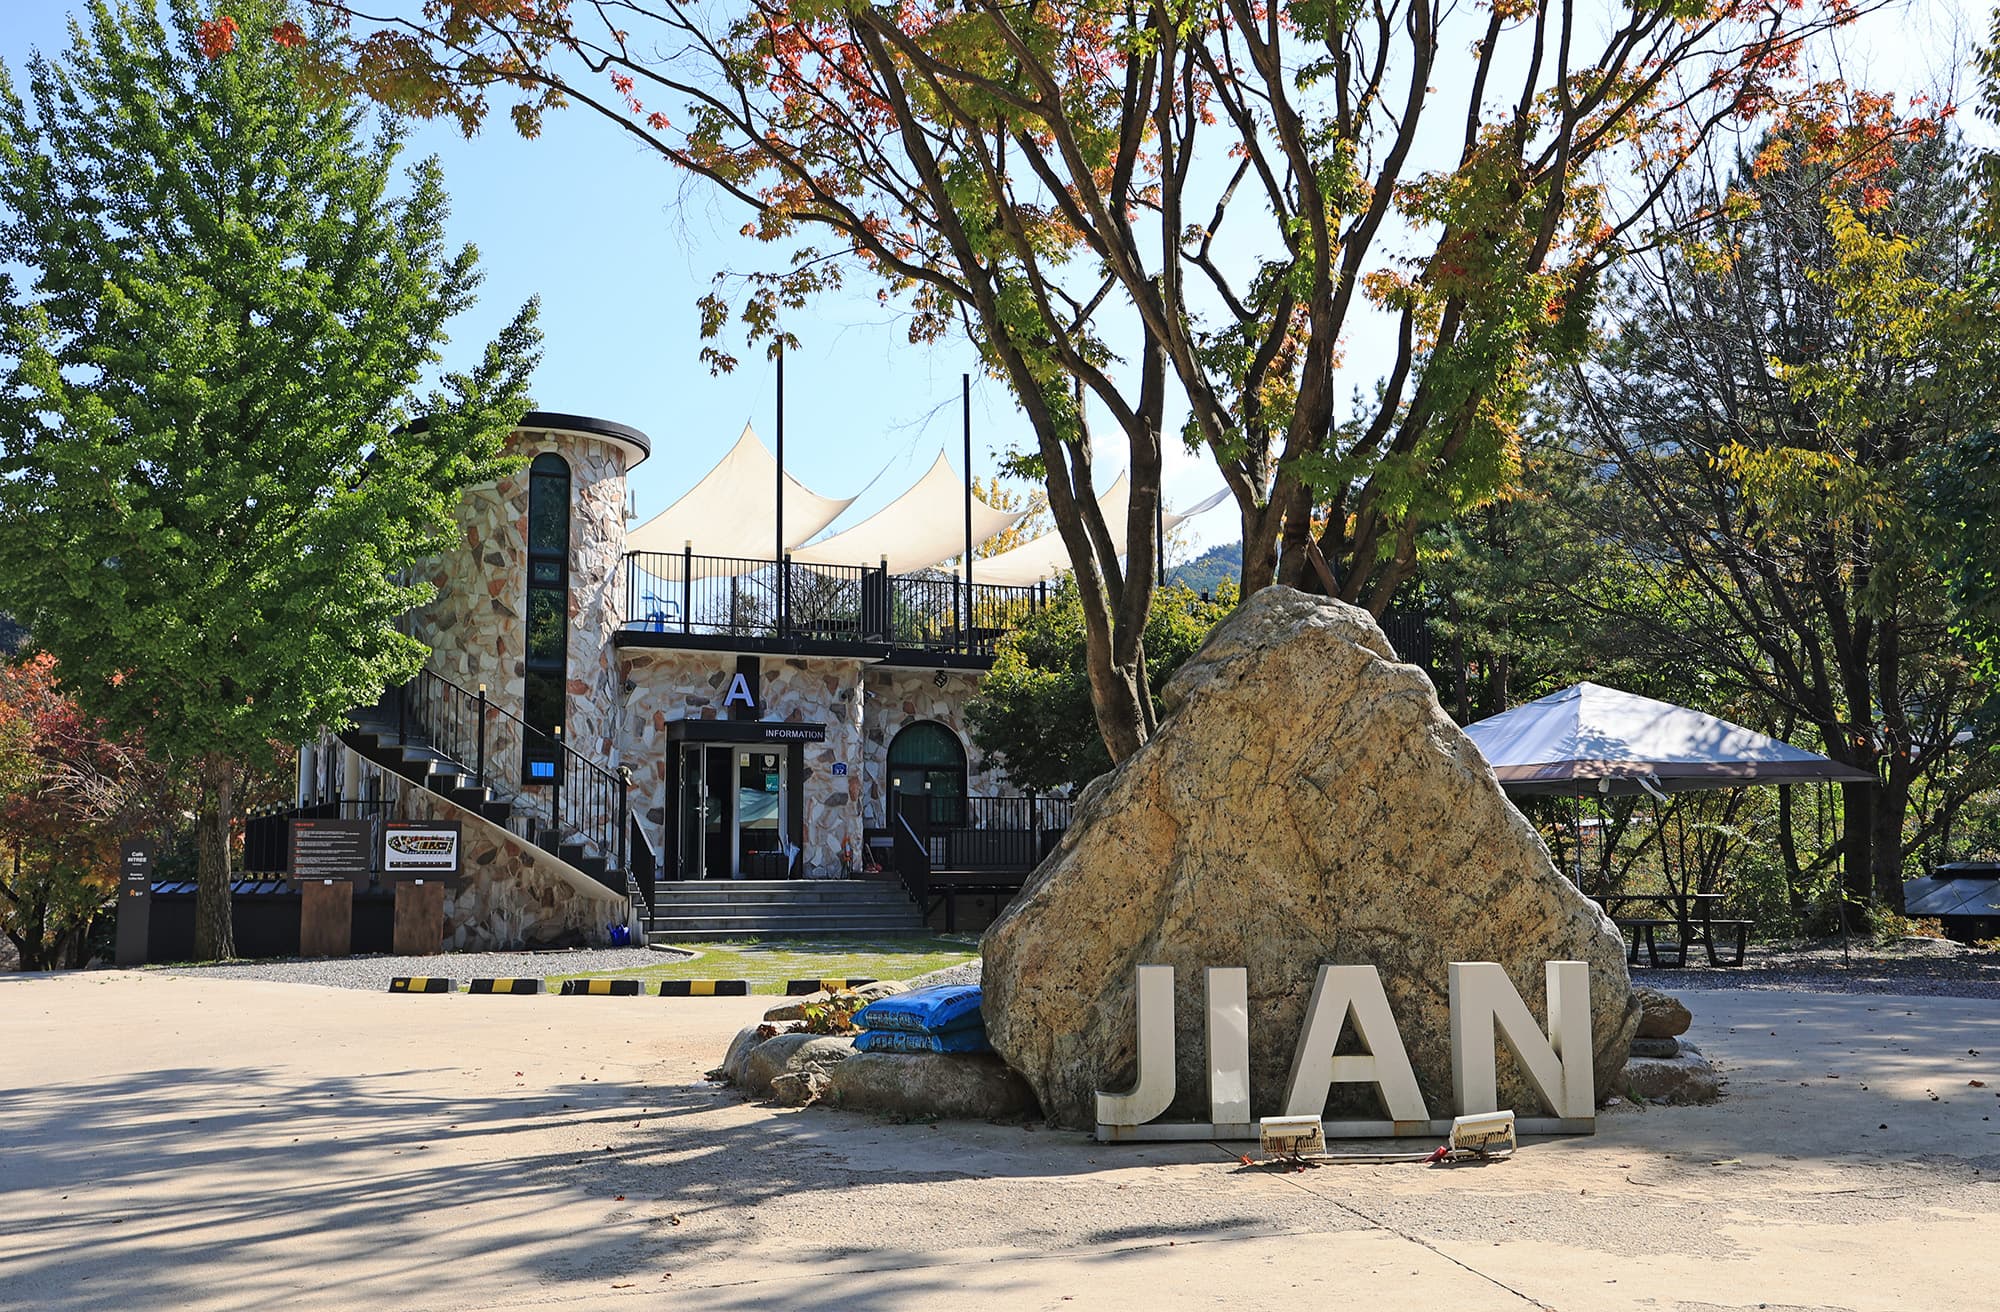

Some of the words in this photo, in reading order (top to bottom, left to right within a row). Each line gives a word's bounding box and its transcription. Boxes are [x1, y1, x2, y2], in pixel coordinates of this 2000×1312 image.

[724, 673, 755, 707] A
[765, 729, 823, 738] INFORMATION
[1095, 960, 1595, 1124] JIAN
